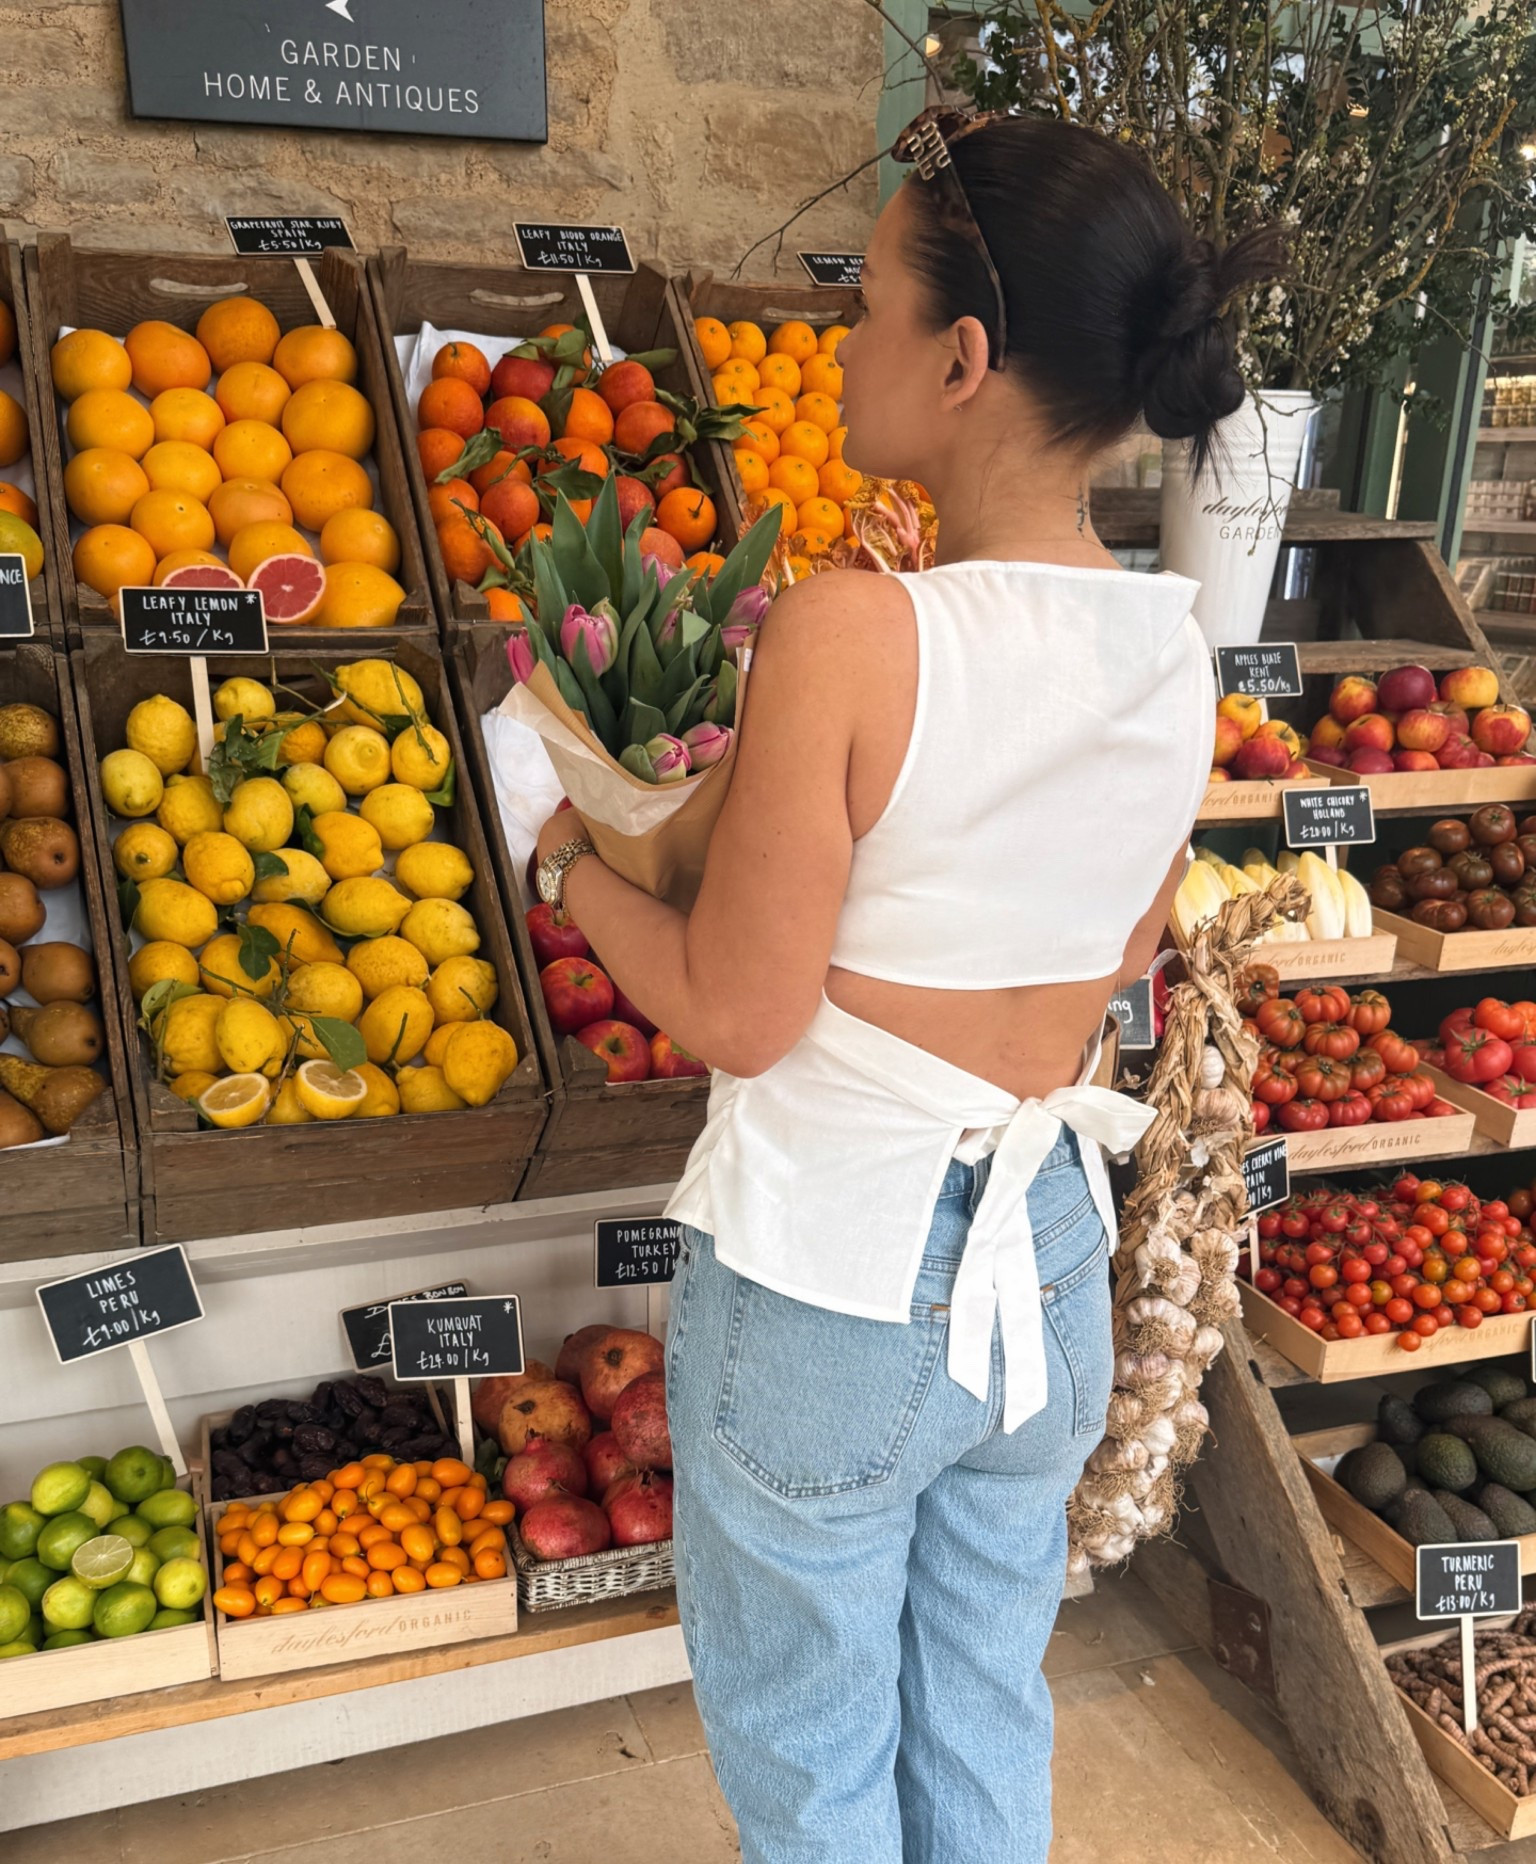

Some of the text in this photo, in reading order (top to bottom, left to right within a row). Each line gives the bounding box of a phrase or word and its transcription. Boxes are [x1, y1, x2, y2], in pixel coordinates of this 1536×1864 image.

[280, 39, 401, 71] GARDEN
[204, 72, 479, 114] HOME & ANTIQUES
[290, 220, 314, 229] STAR
[316, 220, 342, 229] RUBY
[270, 229, 307, 238] SPAIN
[521, 229, 551, 240] LEAFY
[589, 232, 624, 242] ORANGE
[557, 241, 589, 253] ITALY
[142, 595, 239, 611] LEAFY LEMON
[171, 612, 212, 627] ITALY
[1234, 653, 1259, 667] APPLES
[1249, 665, 1270, 678] KENT
[1299, 794, 1355, 809] WHITE CHICORY
[1312, 807, 1346, 820] HOLLAND
[1297, 952, 1347, 966] ORGANIC
[1371, 1134, 1422, 1150] ORGANIC
[1251, 1149, 1273, 1171] CHERRY
[631, 1241, 677, 1259] TURKEY
[86, 1270, 136, 1299] LIMES
[98, 1290, 140, 1315] PERU
[426, 1314, 483, 1335] KUMQUAT
[439, 1331, 473, 1349] ITALY
[1441, 1554, 1495, 1574] TURMERIC
[1454, 1573, 1483, 1592] PERU
[399, 1607, 472, 1634] ORGANIC
